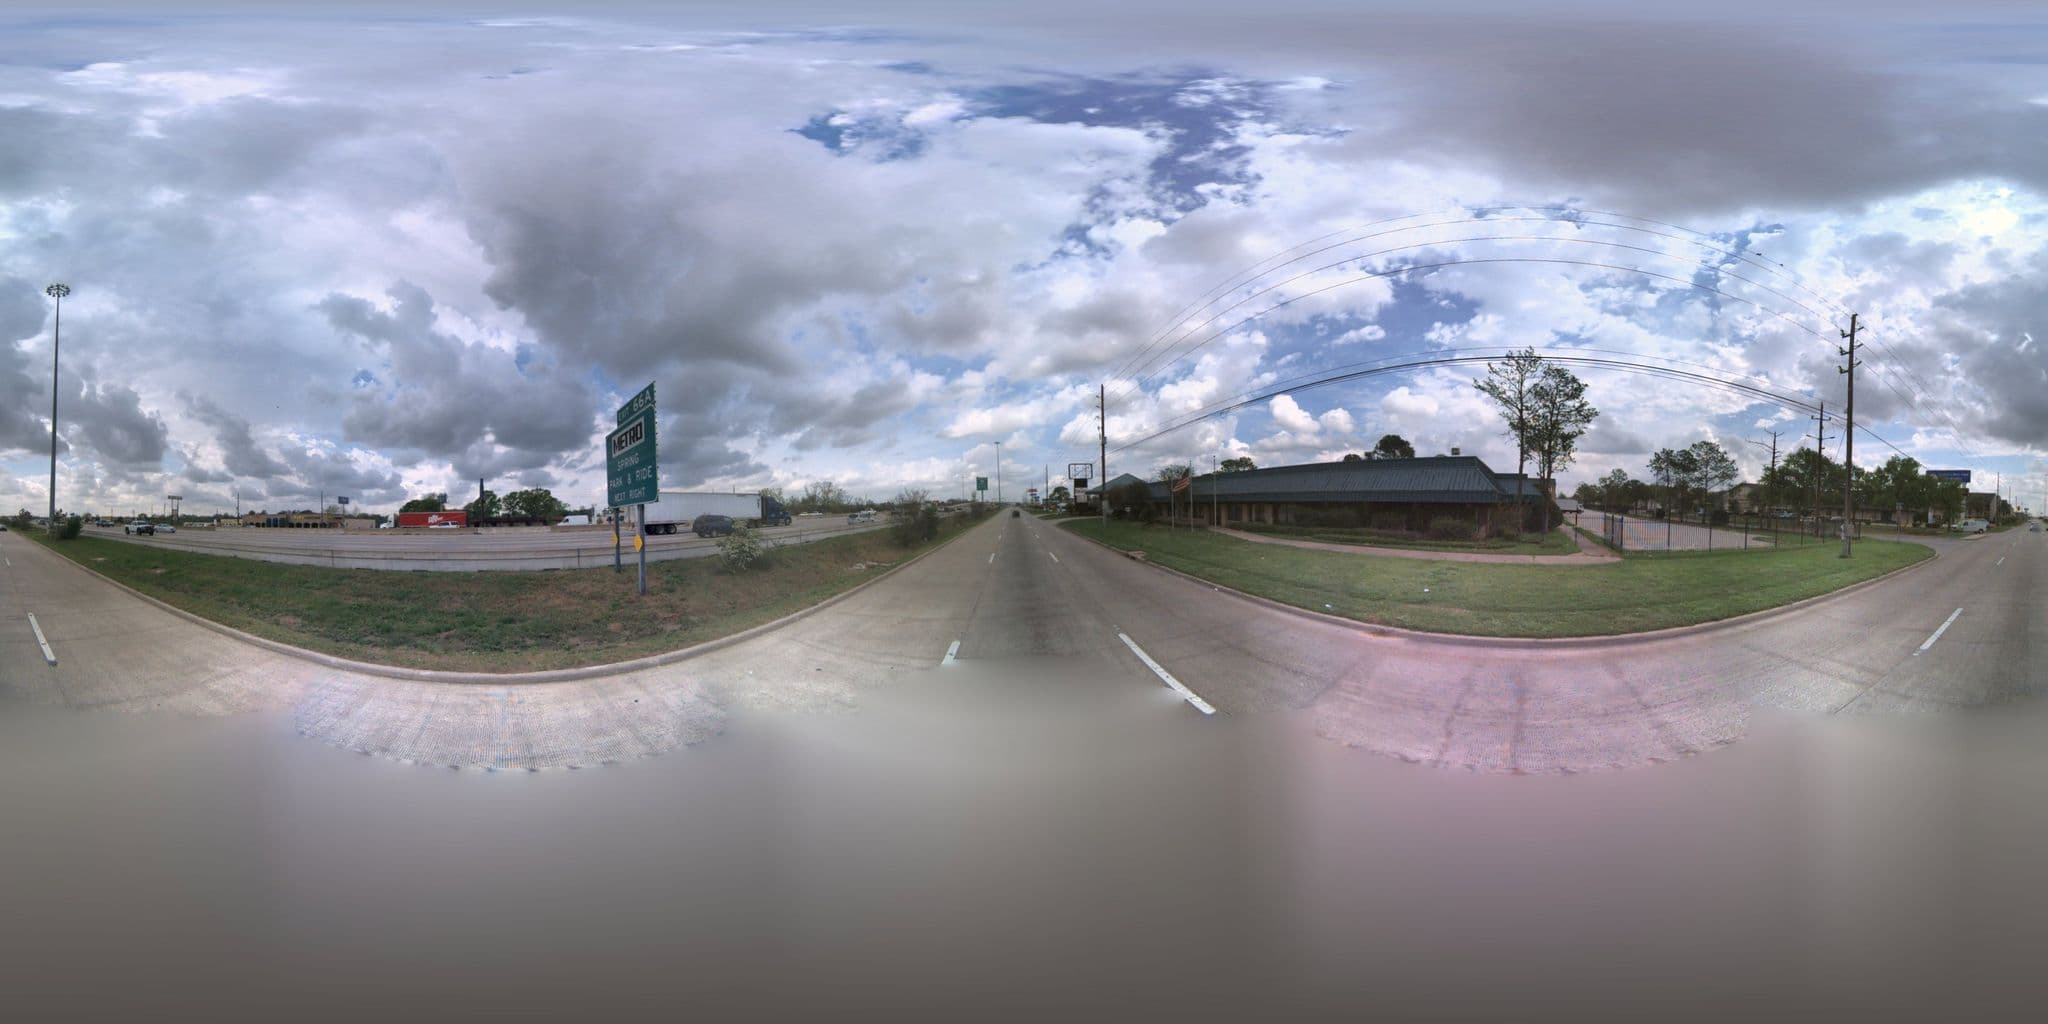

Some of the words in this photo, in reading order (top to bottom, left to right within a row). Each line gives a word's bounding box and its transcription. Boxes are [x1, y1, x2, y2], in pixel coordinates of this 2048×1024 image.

[633, 389, 652, 412] 66A
[613, 423, 643, 455] METRO
[617, 453, 640, 471] SPRING
[609, 476, 623, 489] PARK
[636, 465, 653, 482] RIDE
